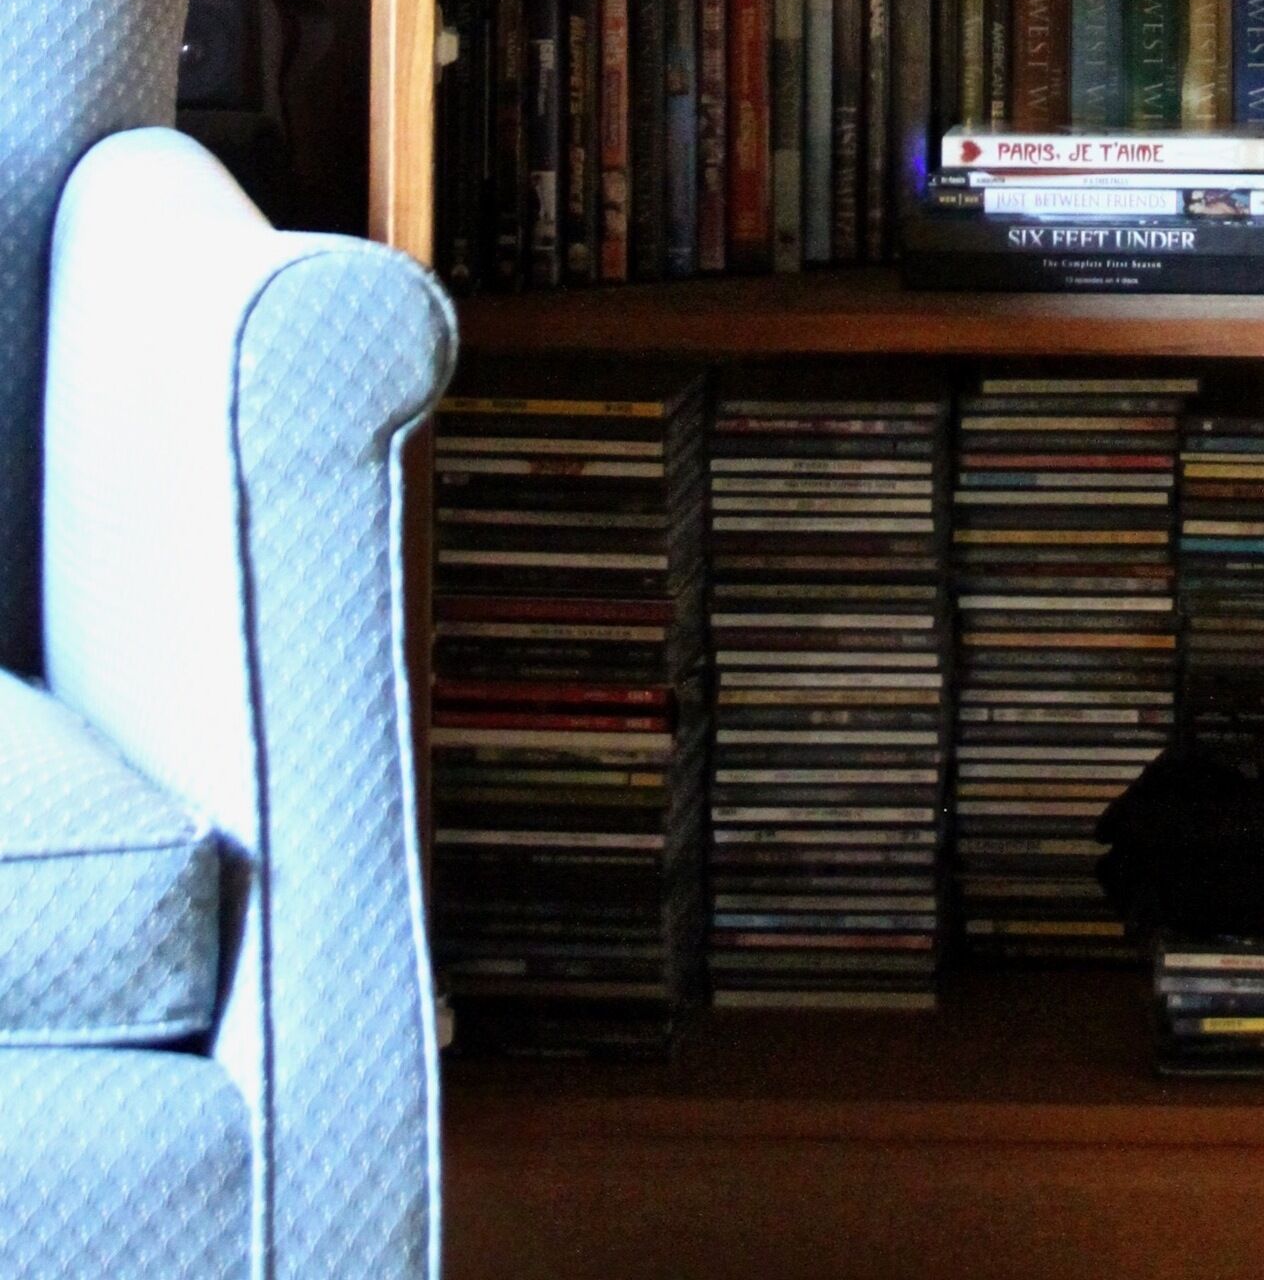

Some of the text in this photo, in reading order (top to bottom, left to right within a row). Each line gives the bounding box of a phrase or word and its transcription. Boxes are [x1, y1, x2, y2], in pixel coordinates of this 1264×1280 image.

[998, 141, 1164, 162] PARIS, JE T'AIME
[996, 191, 1028, 208] JUST
[1034, 191, 1101, 208] BETWEEN
[1106, 191, 1167, 208] FRIENDS
[1008, 229, 1196, 249] SIX FEET UNDER
[1043, 259, 1161, 269] The Complete First Season
